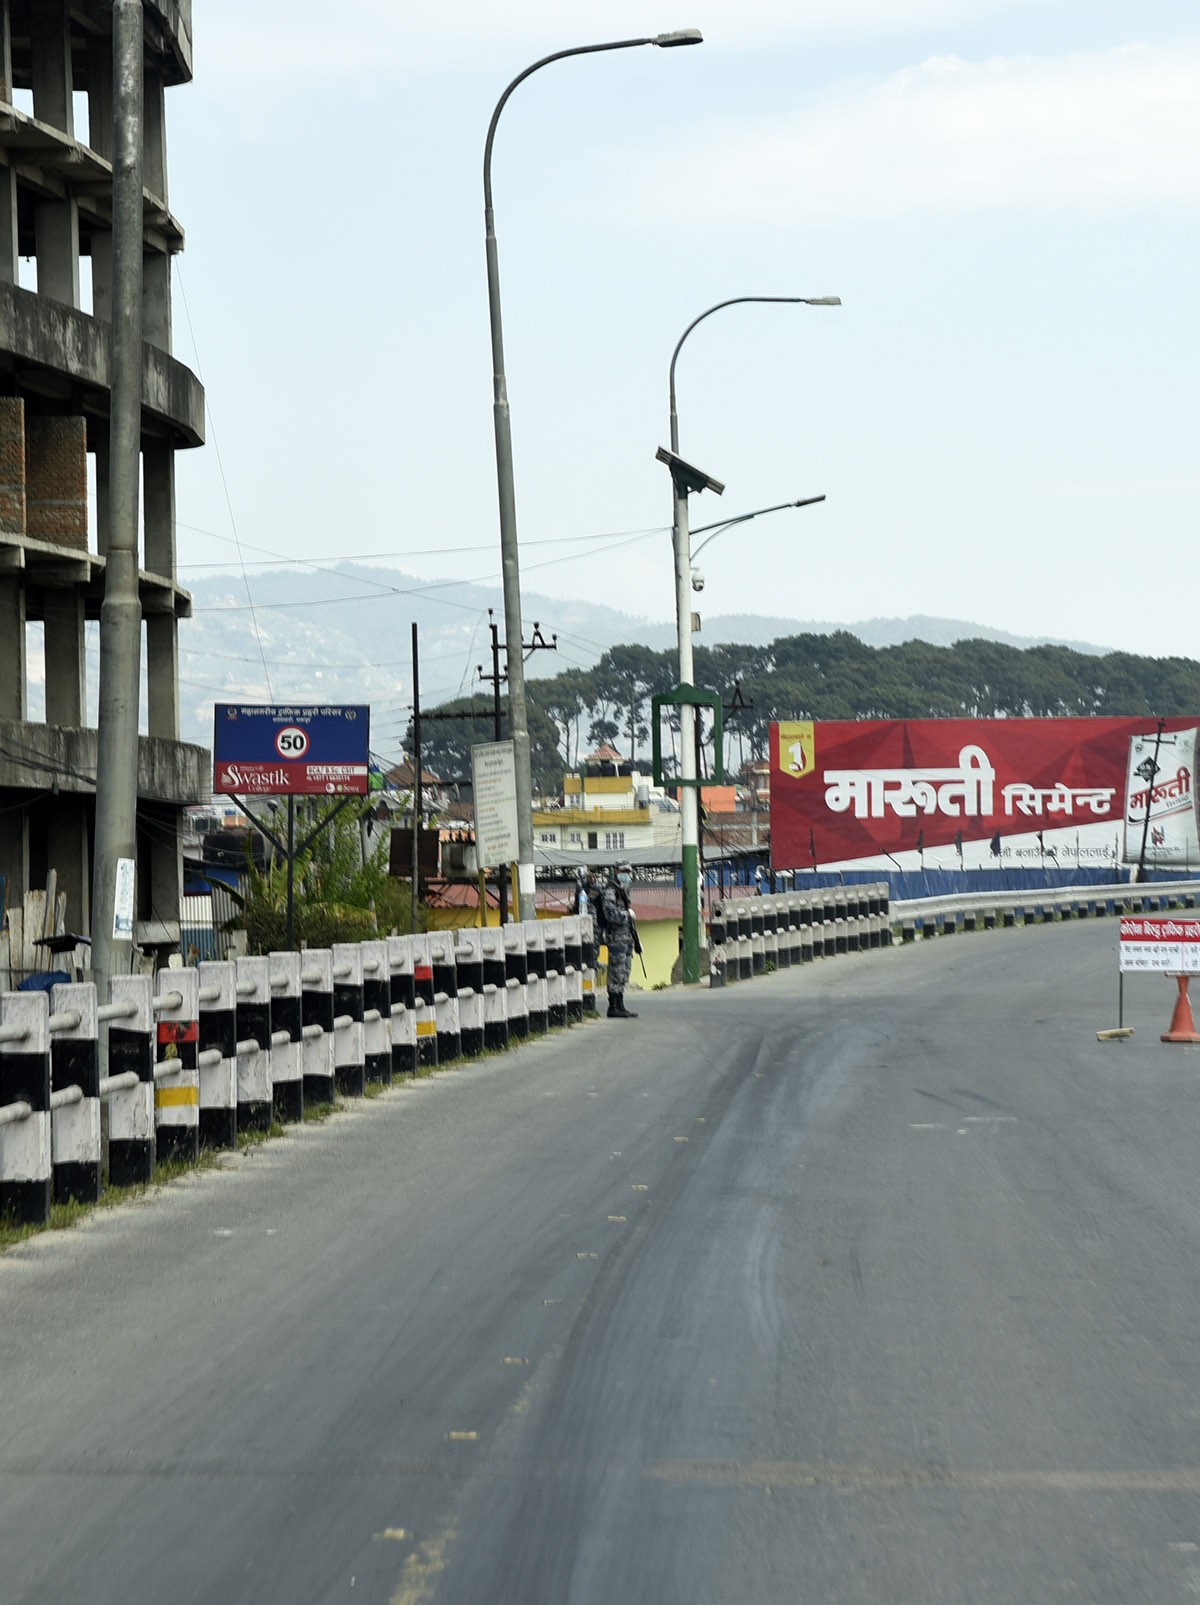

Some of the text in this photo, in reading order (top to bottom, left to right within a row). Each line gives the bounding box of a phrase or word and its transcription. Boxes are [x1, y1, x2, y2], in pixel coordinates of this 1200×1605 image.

[280, 735, 305, 750] 50
[226, 764, 290, 789] Swastik
[1001, 782, 1117, 816] सिमेन्ट
